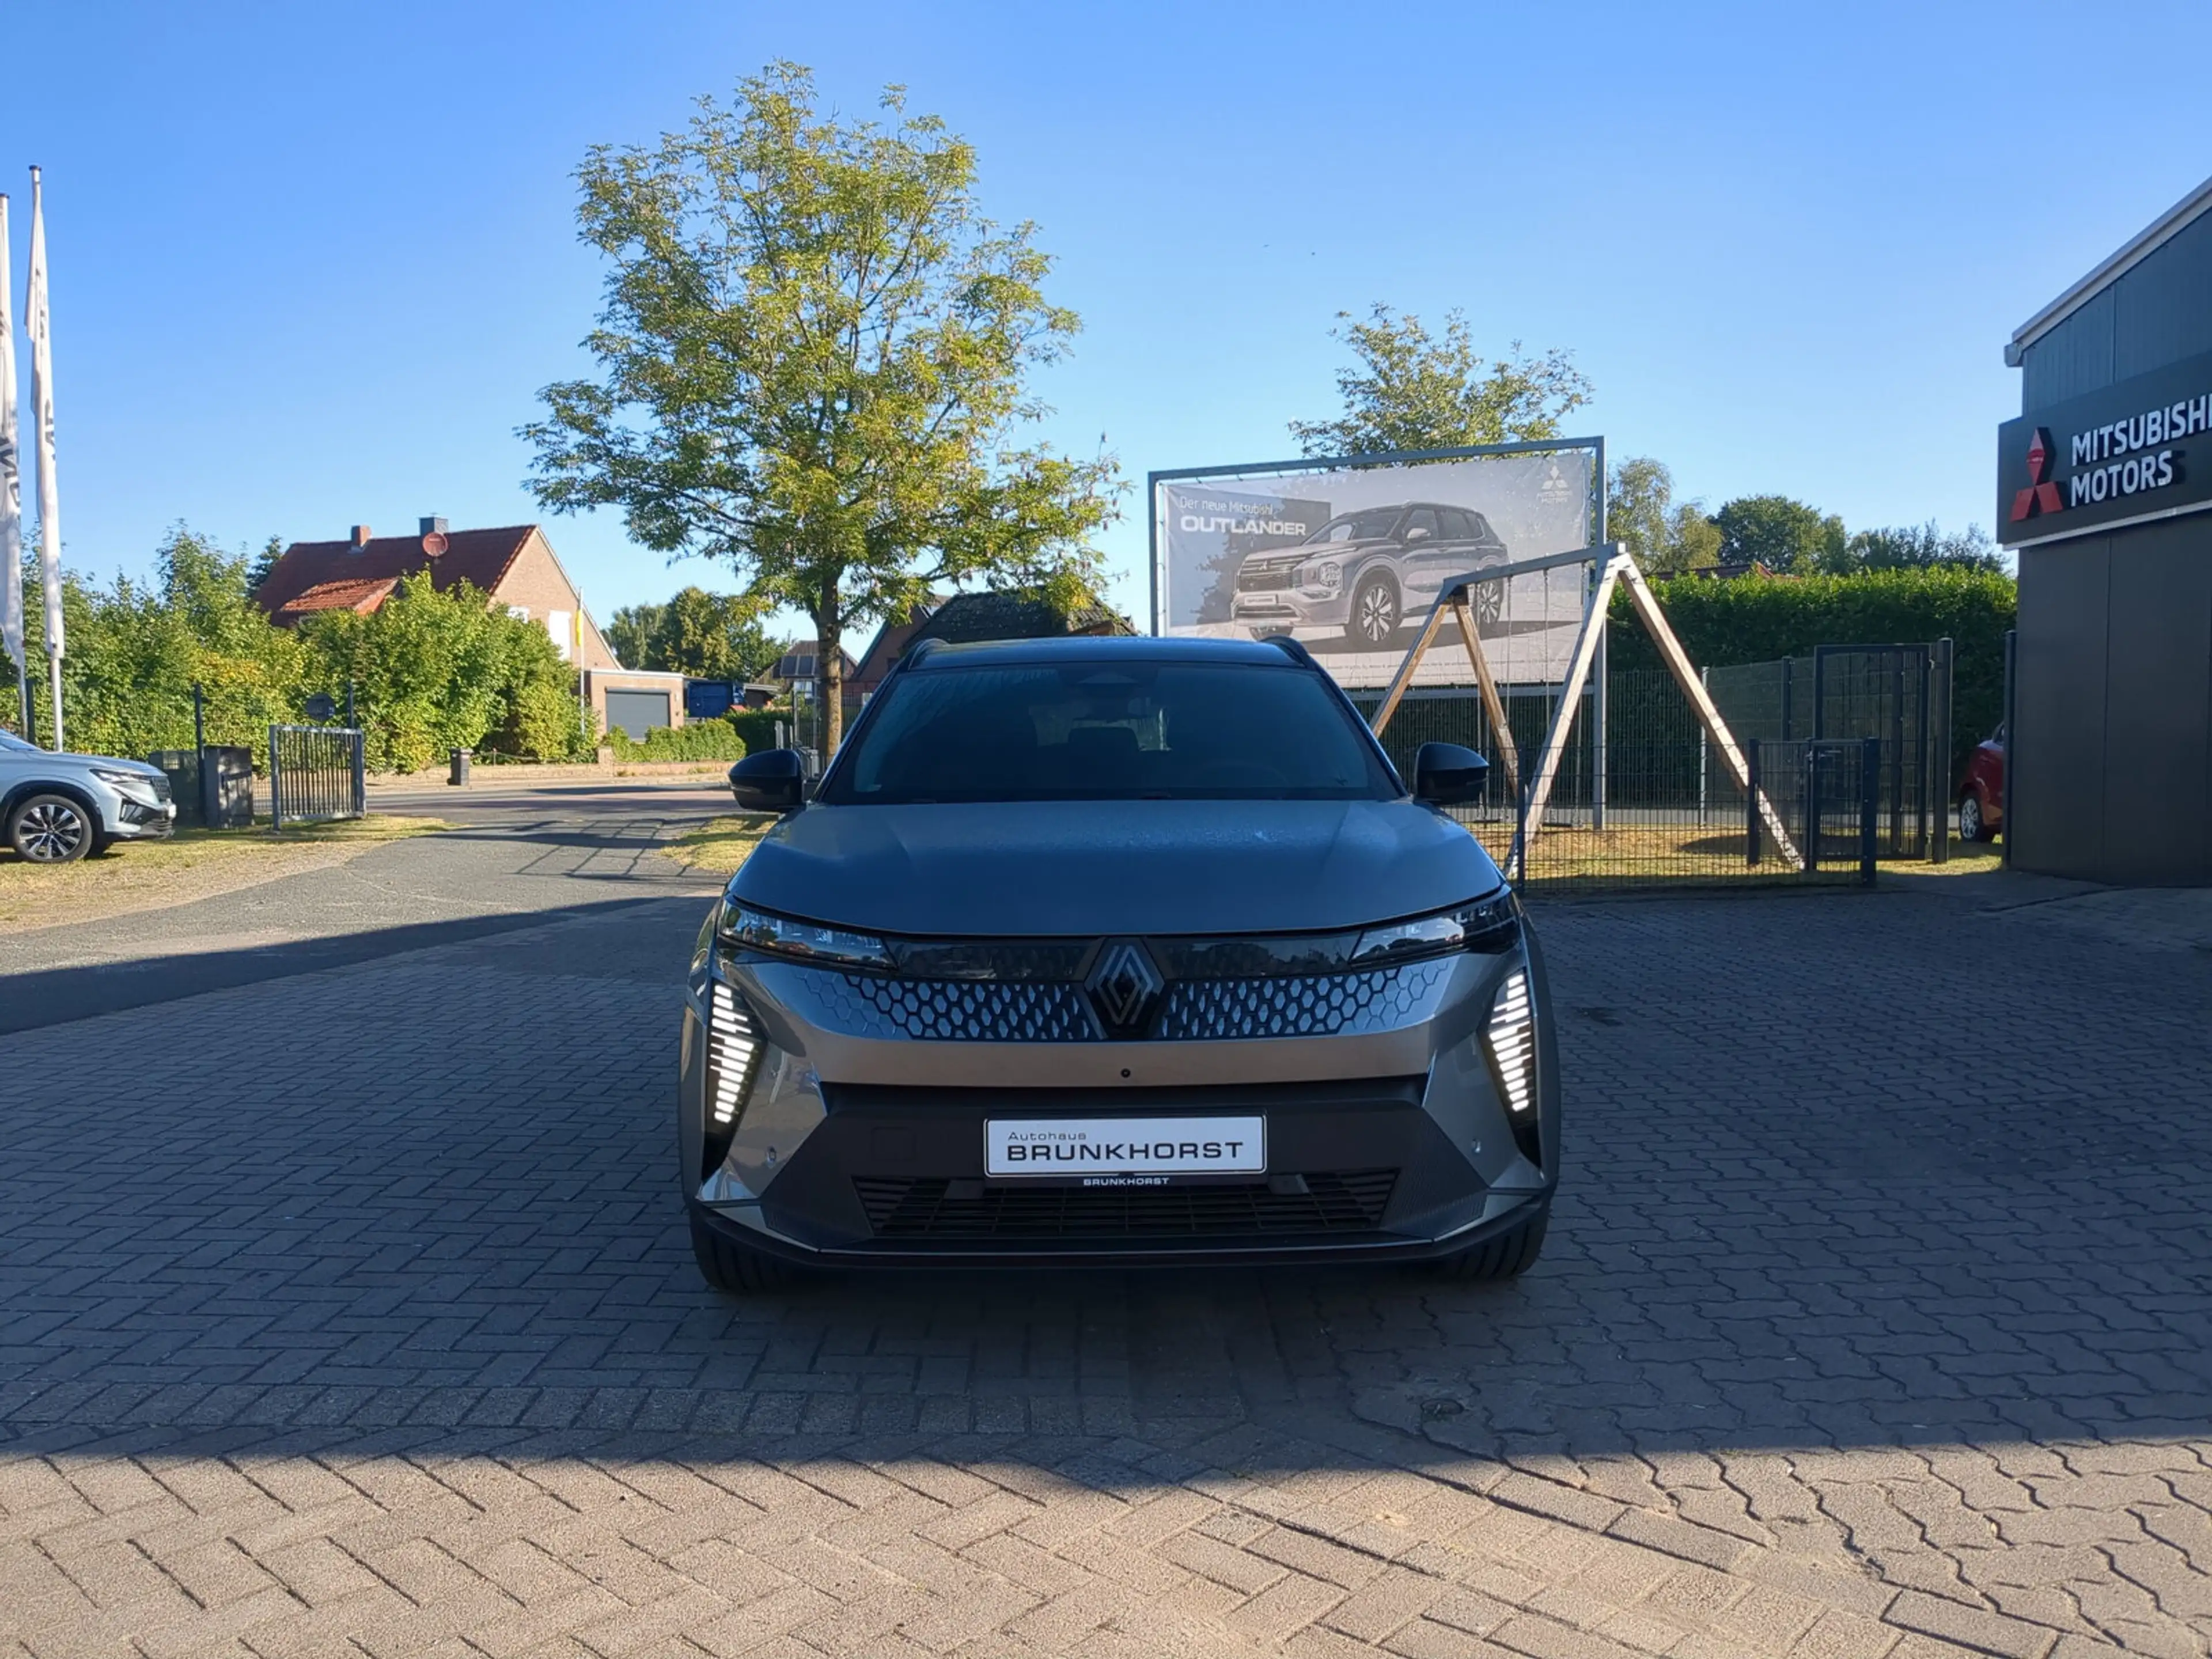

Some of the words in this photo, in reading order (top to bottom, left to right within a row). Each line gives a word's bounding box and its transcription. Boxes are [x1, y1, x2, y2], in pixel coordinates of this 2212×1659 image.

[2071, 450, 2172, 506] MOTORS
[1180, 496, 1198, 509] Der
[1202, 501, 1227, 512] neue
[1229, 501, 1274, 516] Mitsubishi
[1181, 515, 1306, 536] OUTLANDER
[1008, 1131, 1086, 1141] Autohaus
[1007, 1142, 1243, 1161] BRUNKHORST
[1084, 1177, 1169, 1187] BRUNKHORST
